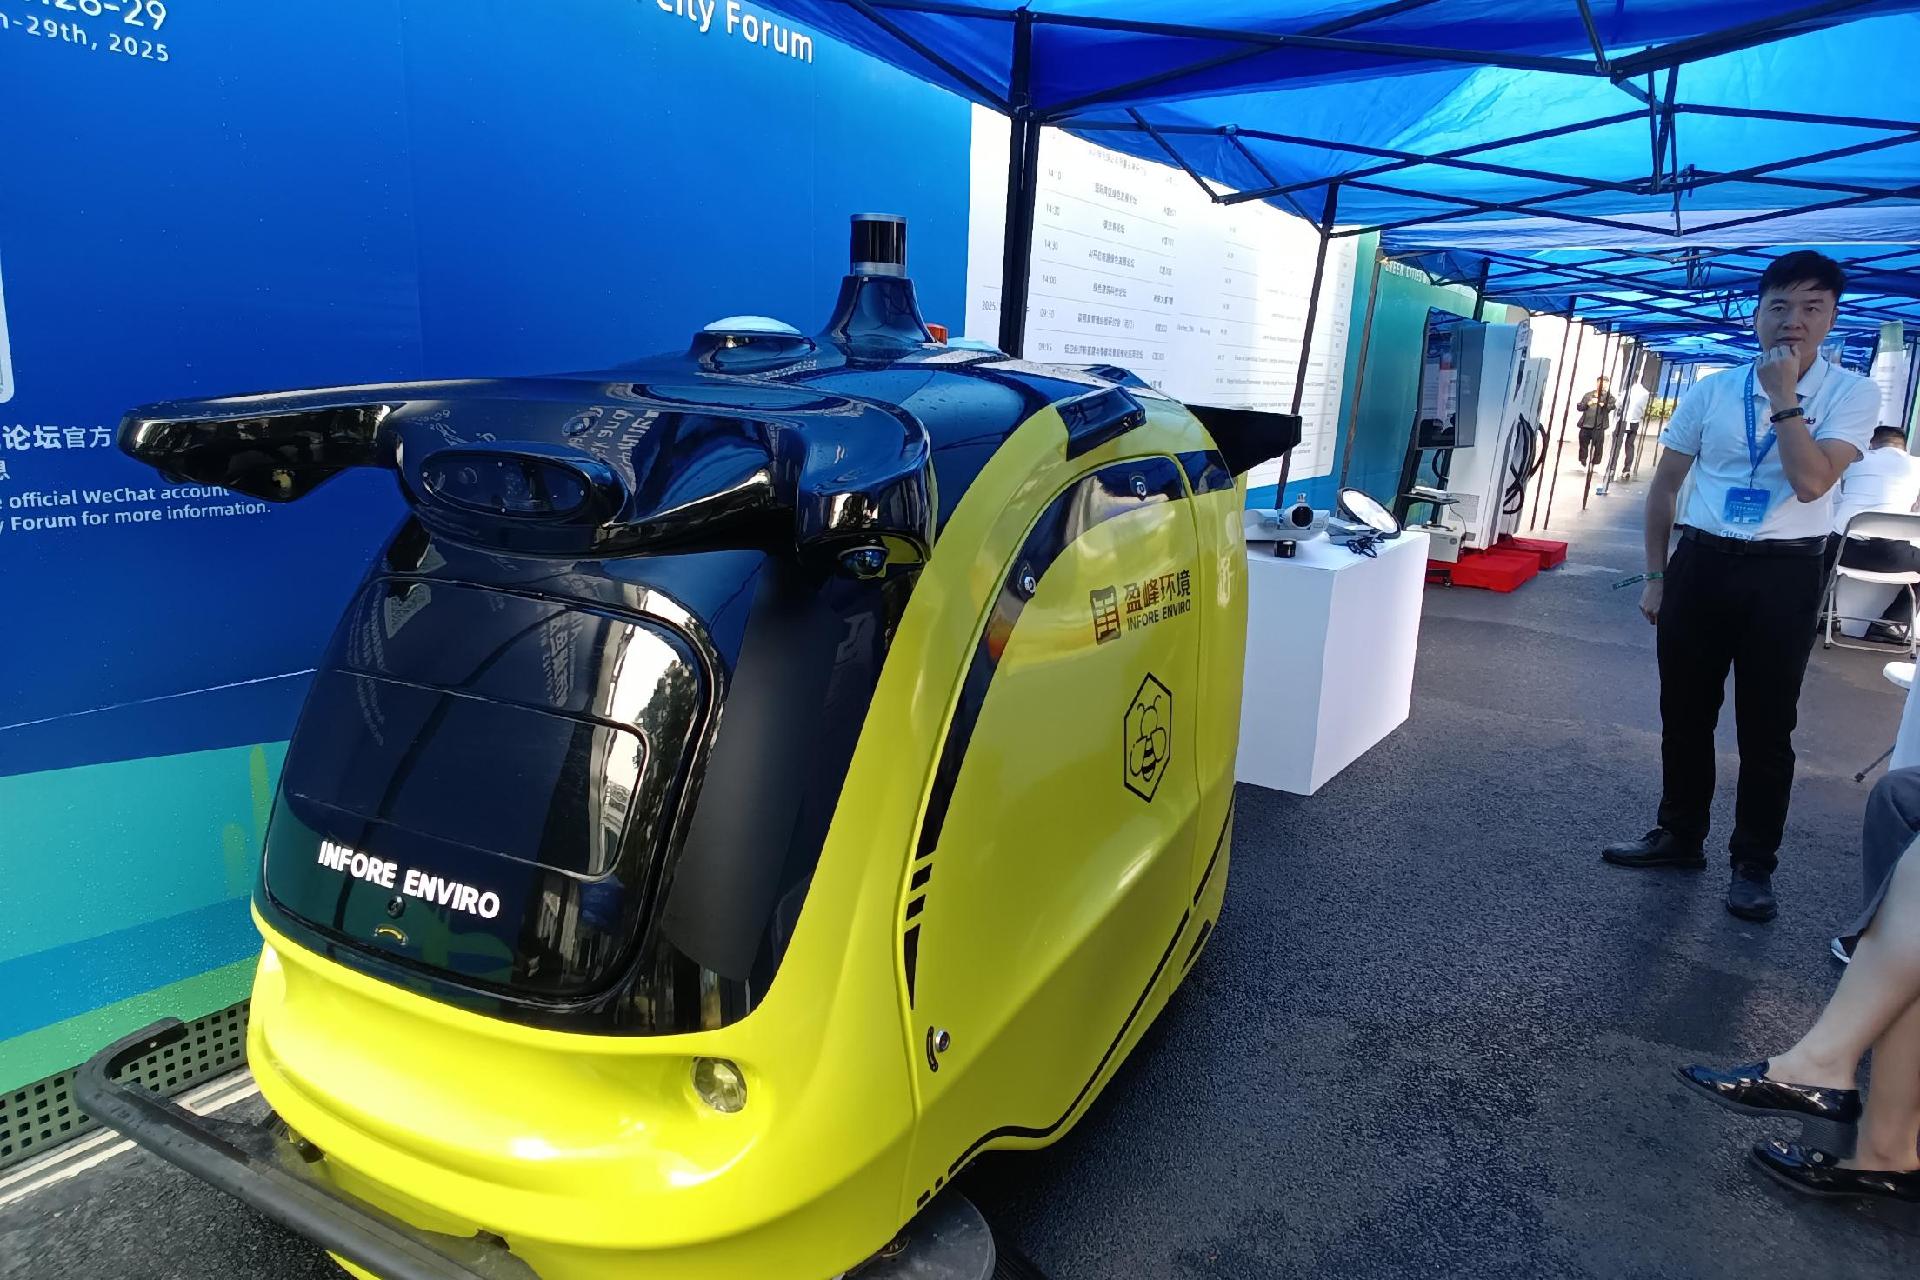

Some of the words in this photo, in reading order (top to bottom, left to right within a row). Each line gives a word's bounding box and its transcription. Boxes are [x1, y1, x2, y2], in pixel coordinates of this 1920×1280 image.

[109, 33, 169, 62] 2025
[726, 0, 813, 64] Forum
[9, 490, 78, 509] official
[82, 487, 157, 504] WeChat
[10, 516, 77, 531] Forum
[82, 511, 109, 526] for
[115, 509, 162, 524] more
[167, 502, 271, 520] information.
[1123, 569, 1191, 614] 盈峰环境
[1126, 609, 1160, 632] INFORE
[1162, 599, 1191, 620] ENVIRO
[317, 840, 398, 889] INFORE
[402, 869, 501, 919] ENVIRO
